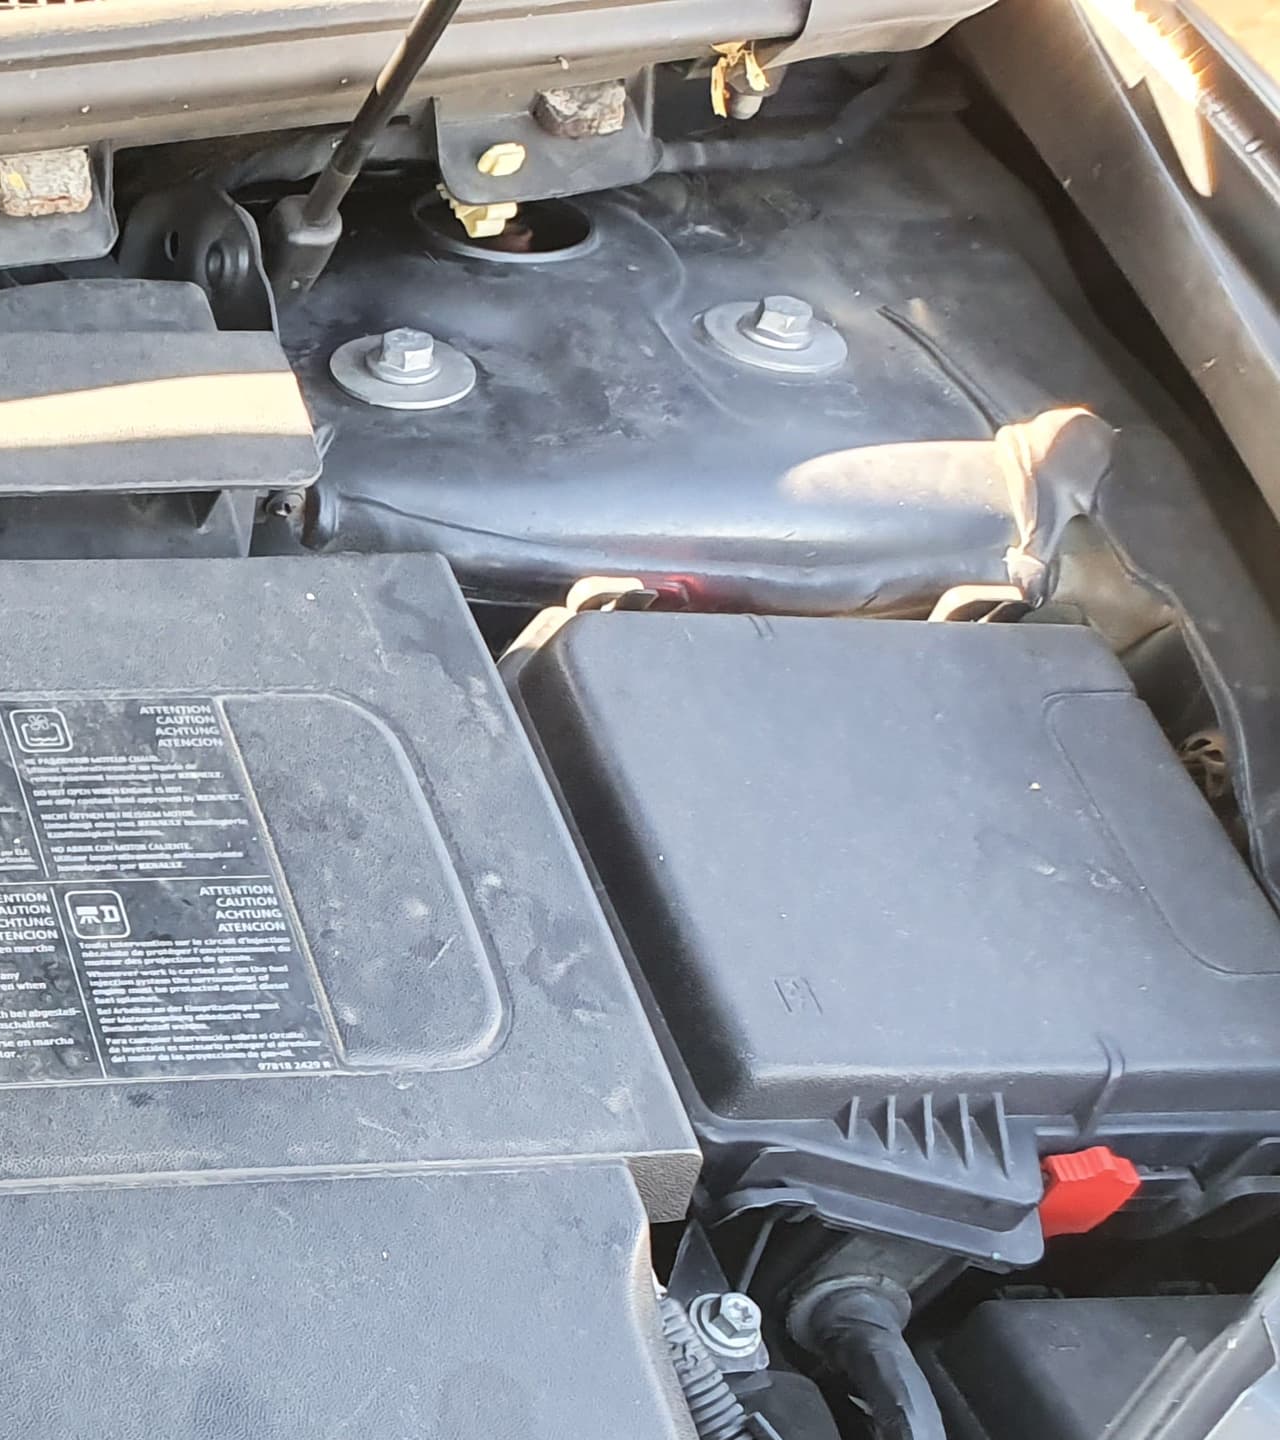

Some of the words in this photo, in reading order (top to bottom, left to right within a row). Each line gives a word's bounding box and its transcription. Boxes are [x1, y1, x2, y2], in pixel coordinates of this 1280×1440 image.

[138, 705, 211, 714] ATTENTION
[155, 715, 215, 724] CAUTION
[154, 726, 219, 736] ACHTUNG
[157, 738, 223, 747] ATENCION
[198, 885, 274, 896] ATTENTION
[215, 896, 278, 907] CAUTION
[214, 908, 282, 919] ACHTUNG
[216, 921, 286, 932] ATENCION
